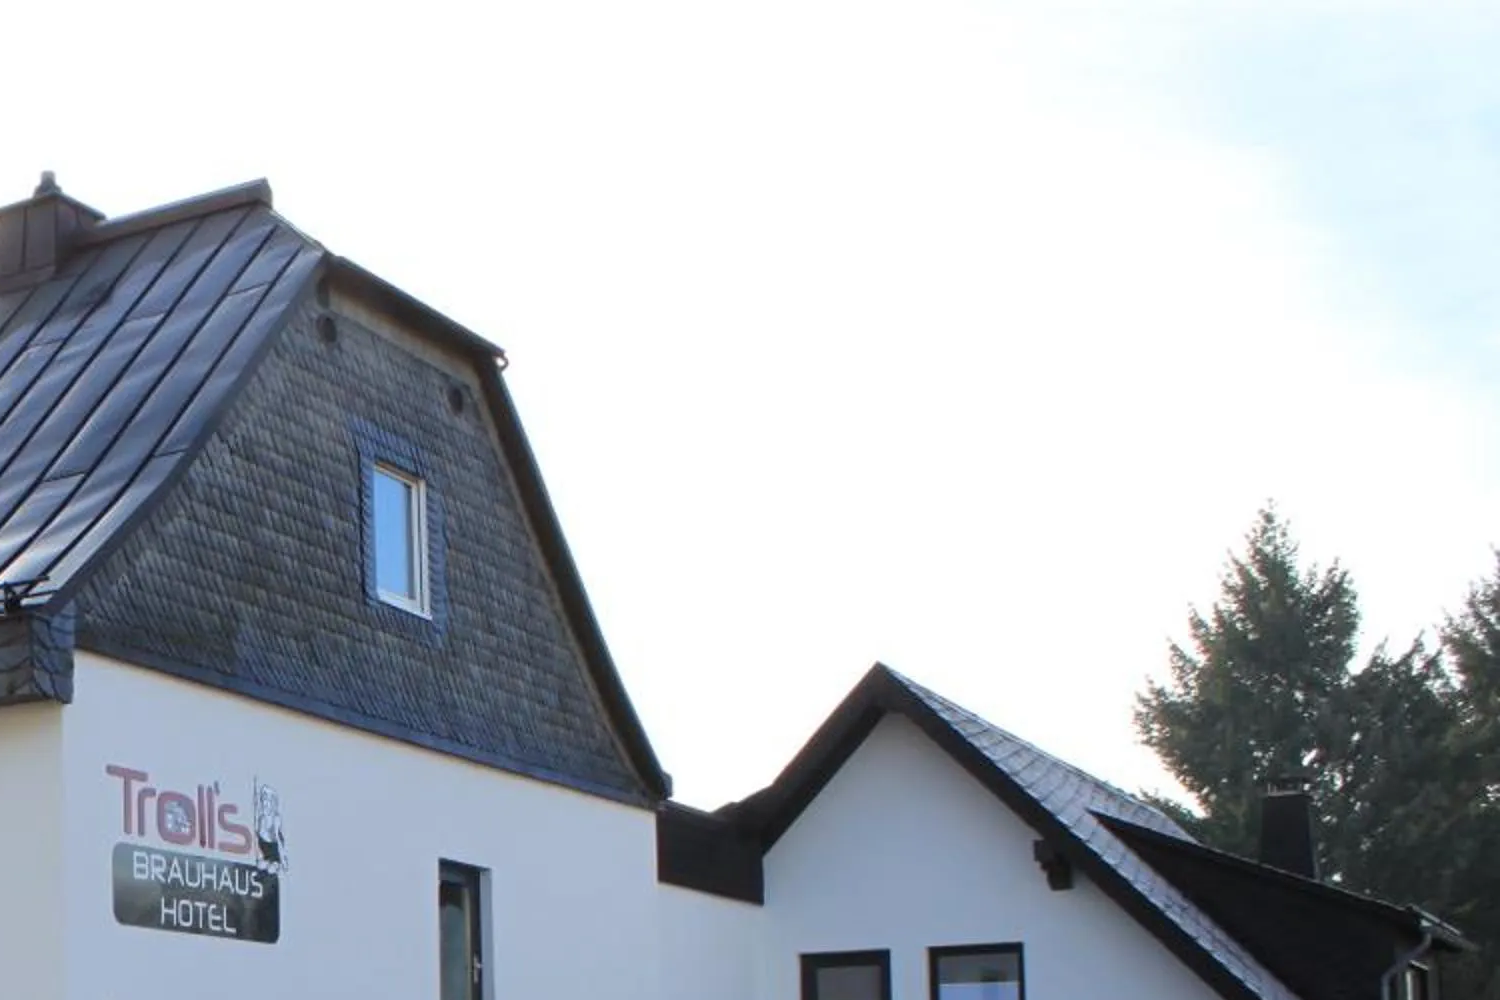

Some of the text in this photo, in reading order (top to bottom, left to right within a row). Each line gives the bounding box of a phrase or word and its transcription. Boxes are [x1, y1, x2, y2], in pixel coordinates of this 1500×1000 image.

[105, 763, 251, 854] Troll's
[132, 851, 263, 898] BRAUHAUS
[160, 897, 237, 933] HOTEL
